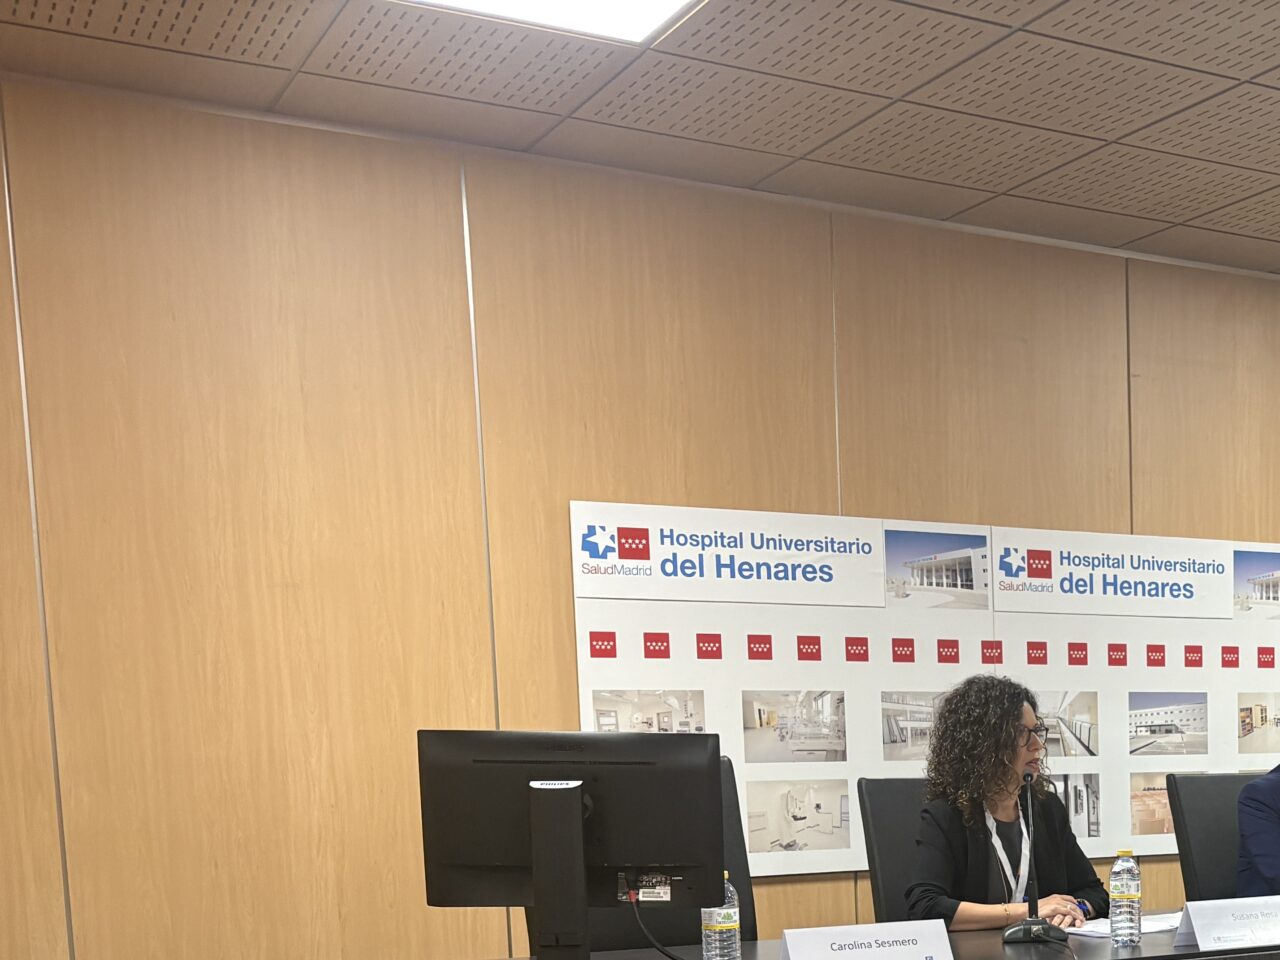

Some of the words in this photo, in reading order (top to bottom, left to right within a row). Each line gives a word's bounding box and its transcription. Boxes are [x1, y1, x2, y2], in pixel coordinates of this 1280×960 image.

[660, 528, 743, 551] Hospital
[751, 533, 873, 555] Universitario
[581, 562, 652, 577] SaludMadrid
[660, 552, 705, 579] del
[715, 555, 834, 583] Henares
[1059, 550, 1125, 571] Hospital
[1130, 555, 1225, 575] Universitario
[999, 580, 1054, 593] SaludMadrid
[1059, 572, 1095, 595] del
[1102, 574, 1195, 600] Henares
[1231, 911, 1259, 921] Susana
[830, 939, 872, 952] Carolina
[874, 937, 918, 949] Sesmero
